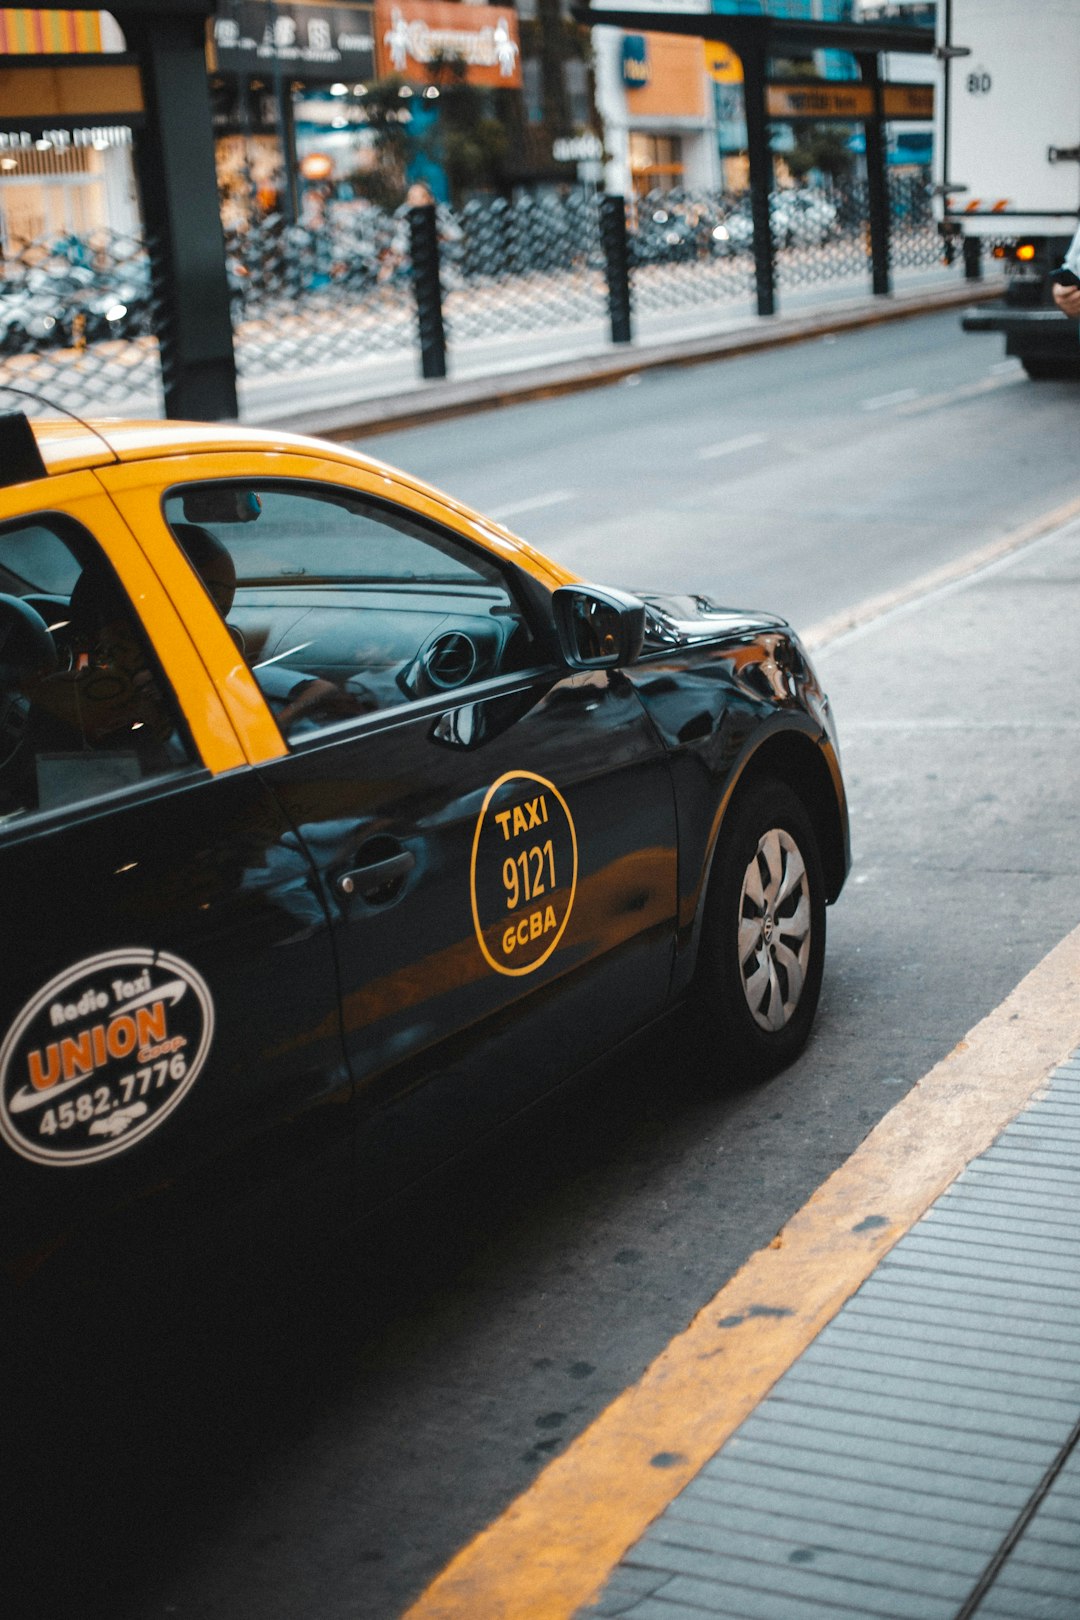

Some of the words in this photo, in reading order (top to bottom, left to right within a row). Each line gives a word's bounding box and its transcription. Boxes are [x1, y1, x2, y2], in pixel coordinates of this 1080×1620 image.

[495, 795, 548, 841] TAXI
[502, 839, 556, 910] 9121
[502, 905, 557, 955] GCBA
[50, 988, 109, 1027] Radio
[111, 968, 151, 1001] Taxi
[27, 1000, 167, 1091] UNION
[39, 1053, 187, 1136] 4582.7776
